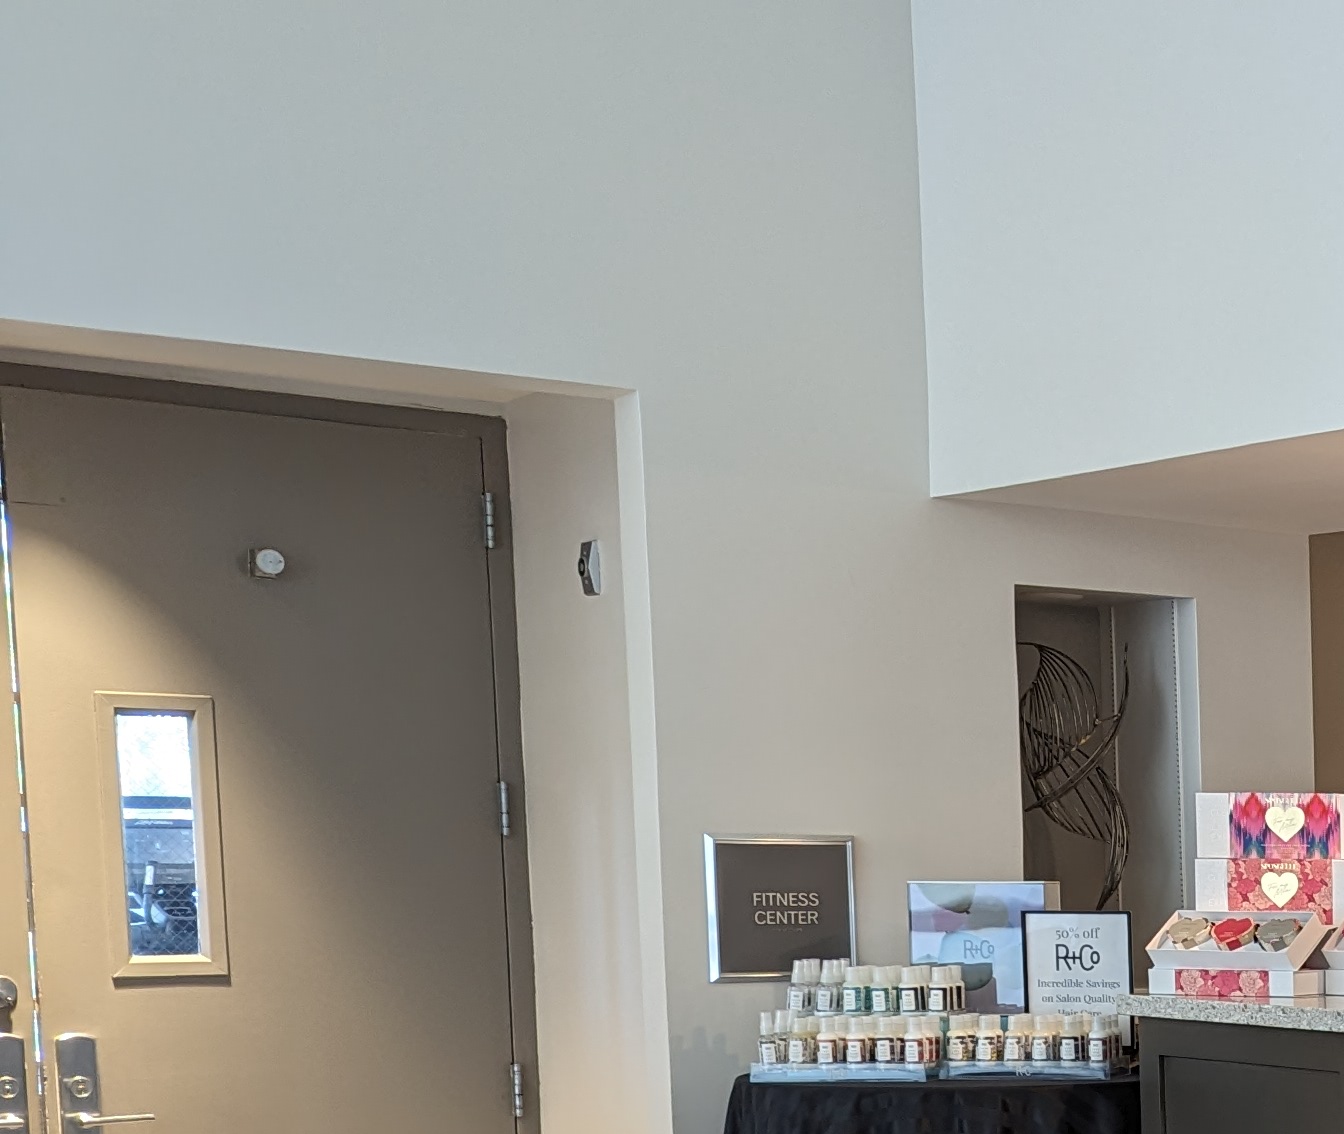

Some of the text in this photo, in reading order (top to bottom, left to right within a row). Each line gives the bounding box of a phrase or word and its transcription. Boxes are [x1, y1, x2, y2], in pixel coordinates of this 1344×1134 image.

[752, 892, 820, 907] FITNESS
[754, 910, 819, 925] CENTER
[1055, 926, 1101, 940] 50% off
[963, 939, 995, 959] R+Co
[1055, 943, 1101, 972] R+Co
[1037, 979, 1121, 989] Incredible Savings
[1056, 994, 1081, 1003] Salon
[1083, 994, 1116, 1004] Quality
